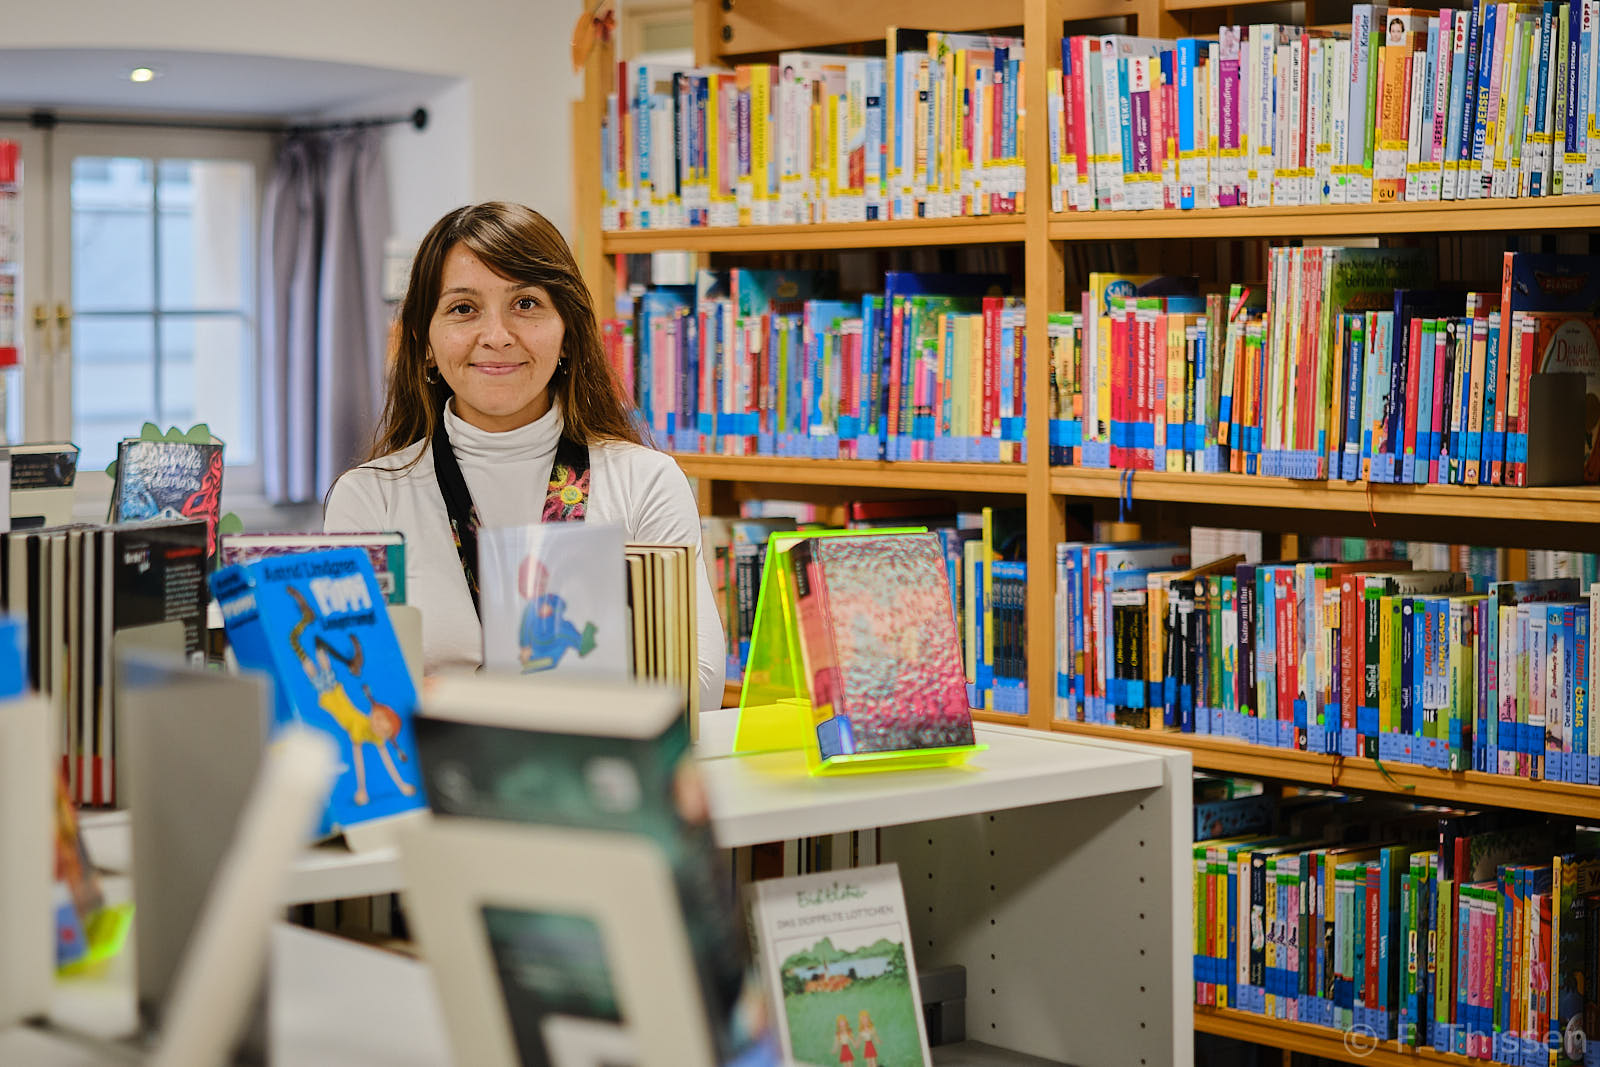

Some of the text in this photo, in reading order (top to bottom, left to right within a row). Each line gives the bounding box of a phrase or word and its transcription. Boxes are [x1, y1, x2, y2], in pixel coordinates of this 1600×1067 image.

[1360, 15, 1369, 48] Kinder
[1456, 16, 1464, 50] TOPP
[1543, 12, 1551, 34] MAMA
[1352, 15, 1360, 83] Medikamente
[1542, 35, 1550, 62] STRICKT
[1135, 60, 1143, 88] TOPP
[1557, 62, 1566, 101] Maschen
[1383, 83, 1392, 120] Kinder
[1391, 57, 1402, 140] GESUNDHEITSBUCH
[1568, 70, 1576, 117] SKANDINAVISCH
[1433, 114, 1443, 146] JERSEY
[1472, 85, 1489, 160] ALLES JERSEY
[1361, 276, 1384, 289] Hahn
[1241, 605, 1249, 619] mit
[1241, 620, 1249, 644] Katze
[1424, 611, 1432, 677] LAMA-GANG
[1438, 611, 1446, 677] LAMA-GANG
[1564, 648, 1572, 678] Panther
[1564, 679, 1572, 713] schwarze
[1574, 686, 1584, 728] OSKAR
[777, 904, 894, 930] DAS DOPPELTE LOTTCHEN
